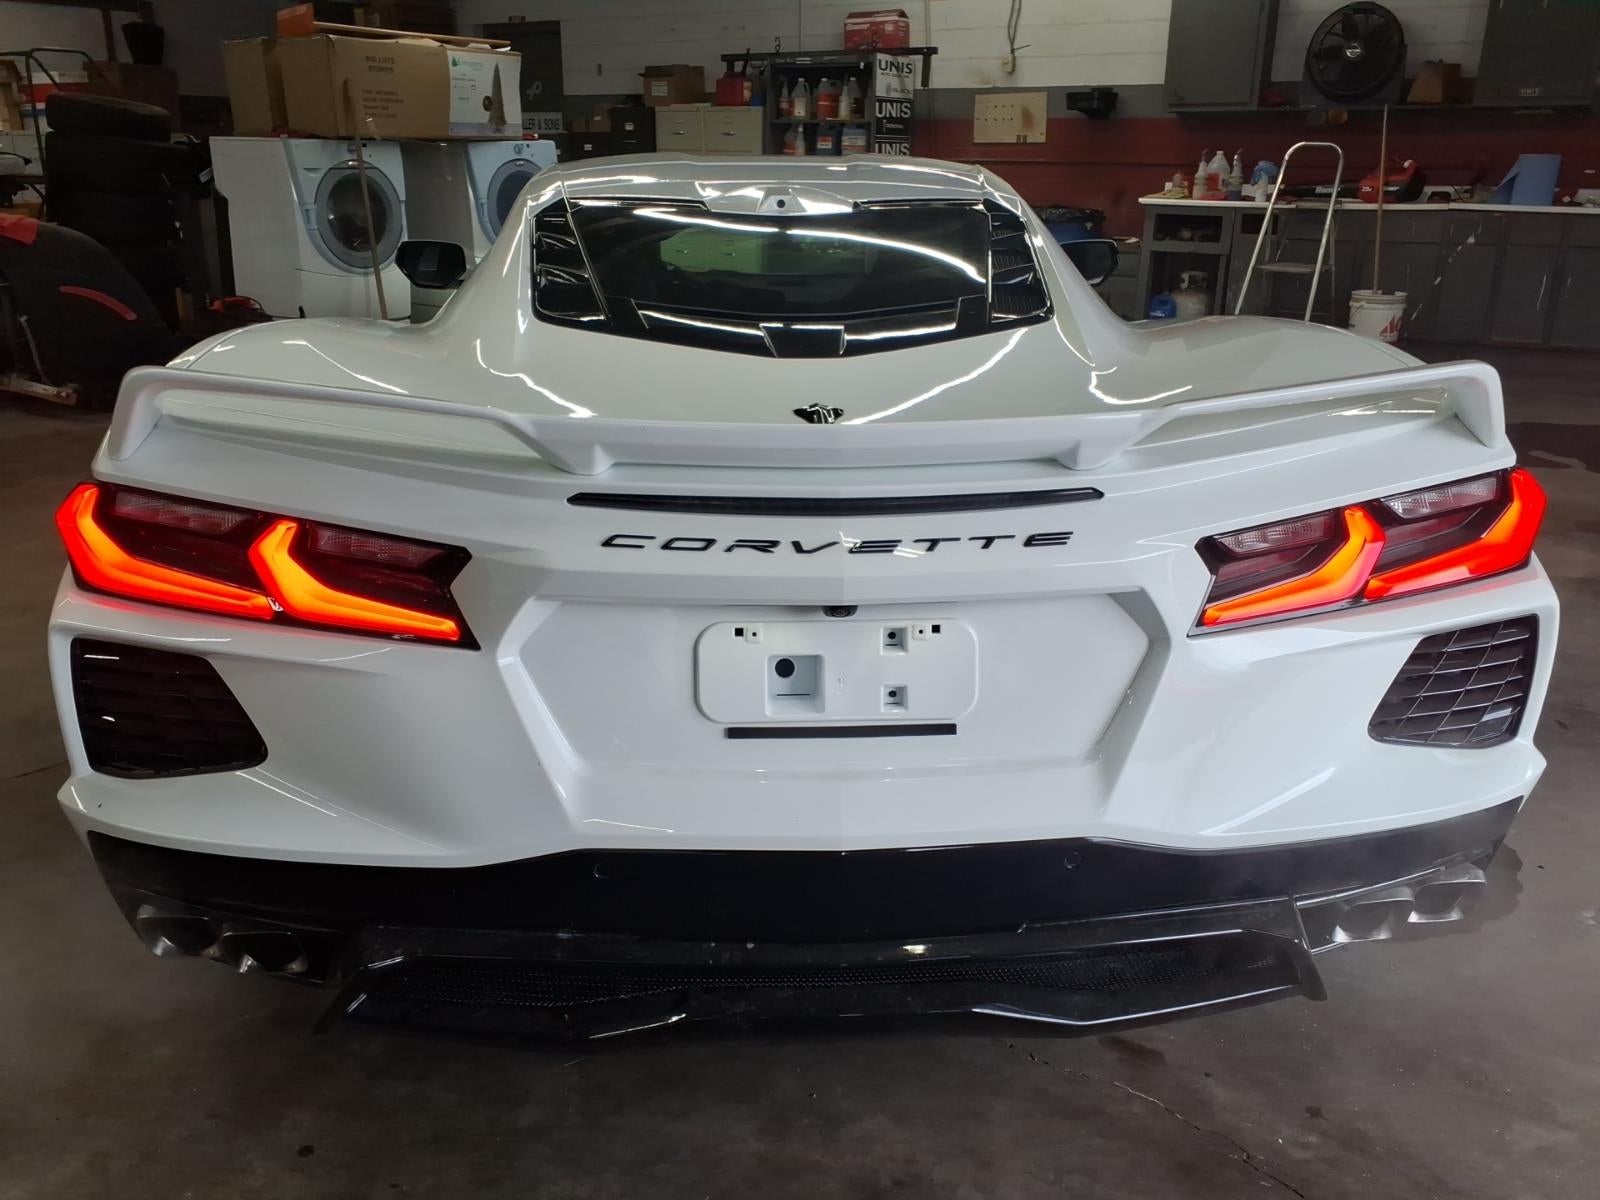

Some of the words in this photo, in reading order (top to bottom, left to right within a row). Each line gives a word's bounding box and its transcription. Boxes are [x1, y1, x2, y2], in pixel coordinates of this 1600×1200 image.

[878, 58, 913, 75] UNIS
[875, 101, 912, 118] UNIS
[600, 531, 1074, 555] CORVETTE
